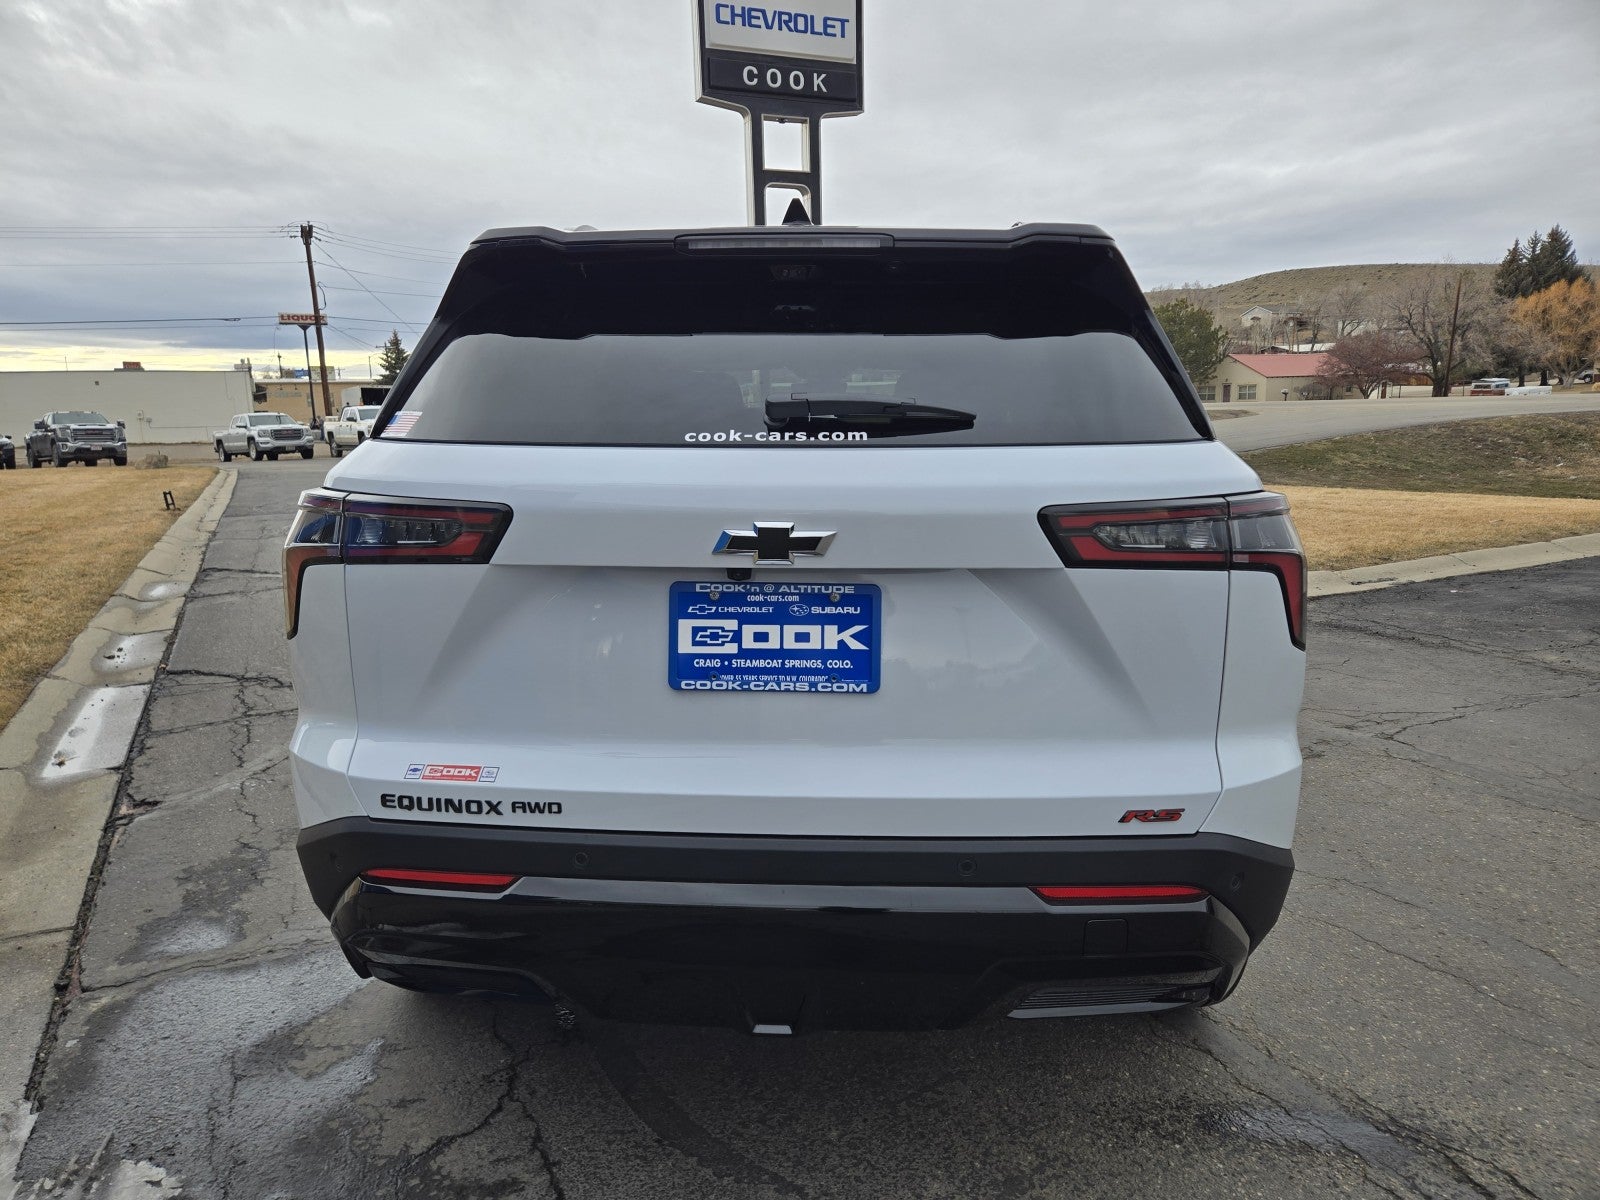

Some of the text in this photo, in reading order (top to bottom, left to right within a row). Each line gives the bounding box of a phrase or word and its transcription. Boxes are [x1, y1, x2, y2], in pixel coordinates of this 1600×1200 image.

[715, 3, 849, 38] CHEVROLET
[743, 65, 828, 93] COOK
[684, 429, 868, 442] cook-cars.com
[763, 584, 775, 593] @
[778, 585, 855, 594] ALTITUDE
[747, 594, 800, 602] cook-cars.com
[811, 606, 861, 614] SUBARU
[678, 619, 869, 654] COOK
[693, 659, 854, 670] CRAIG STEAMBOAT SPRINGS, COLO.
[680, 680, 868, 693] COOK-CARS.COM
[424, 766, 478, 777] COOK
[380, 793, 563, 815] EQUINOX AWD
[1118, 808, 1186, 823] RS
